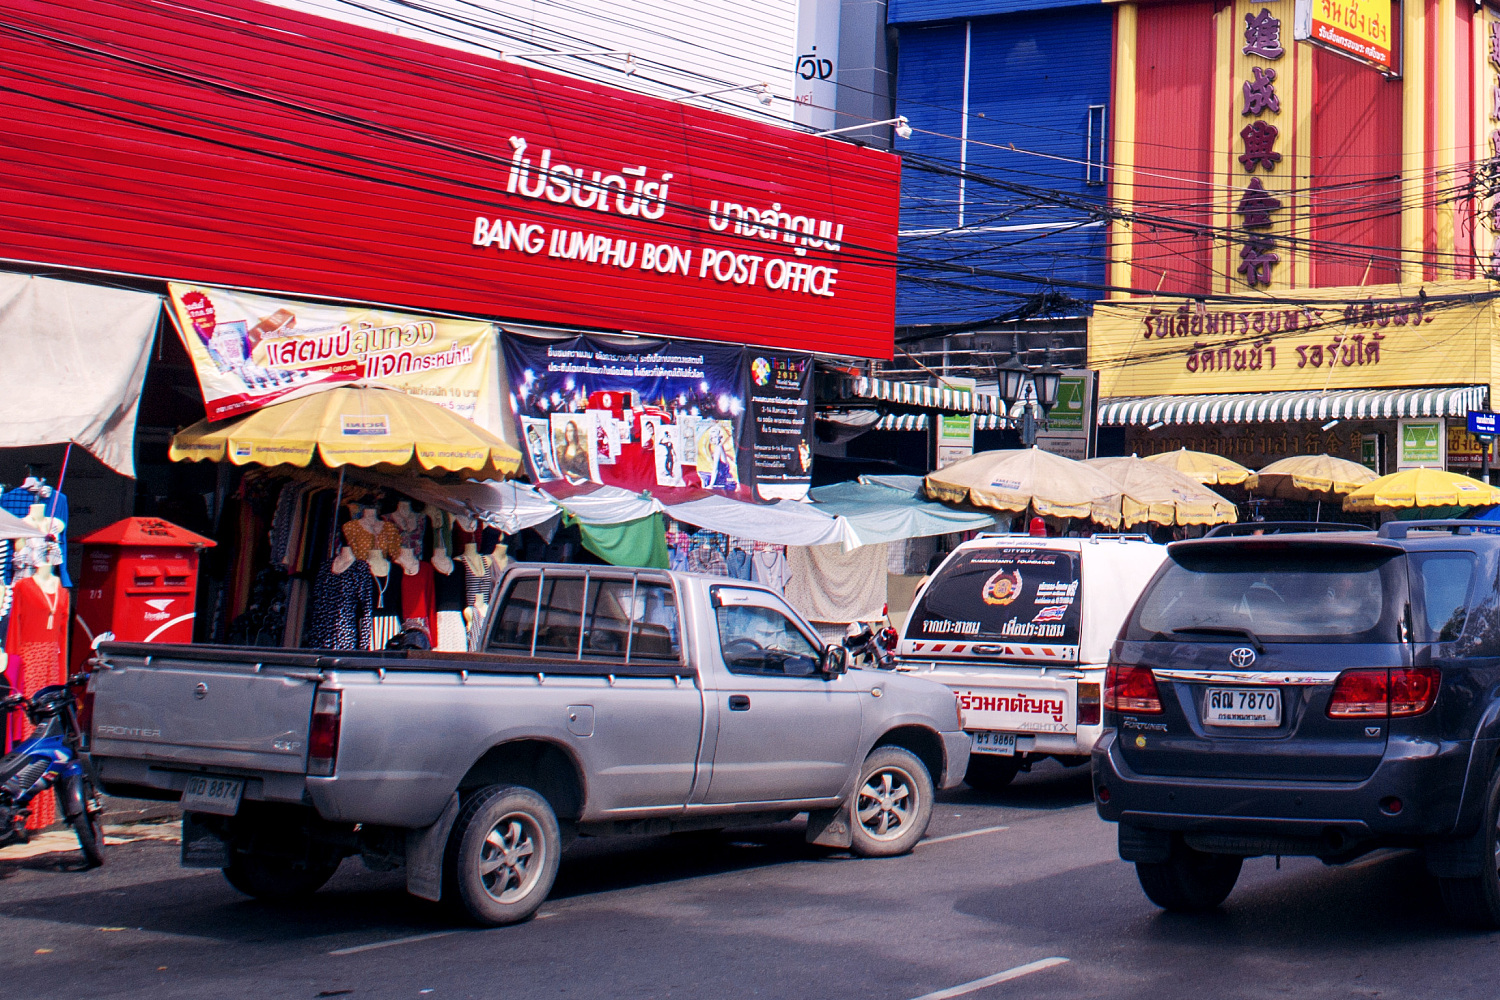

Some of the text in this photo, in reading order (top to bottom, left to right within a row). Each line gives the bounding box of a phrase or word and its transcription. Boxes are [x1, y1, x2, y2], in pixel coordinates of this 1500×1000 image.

[505, 135, 674, 221] ไปรษณีย์
[472, 216, 840, 298] BANG LUMPHU BON POST OFFICE
[777, 371, 797, 380] 2013
[1238, 692, 1275, 710] 7870
[98, 725, 161, 737] FRONTIER
[1123, 721, 1168, 732] FORTUNER
[208, 781, 238, 800] 8874
